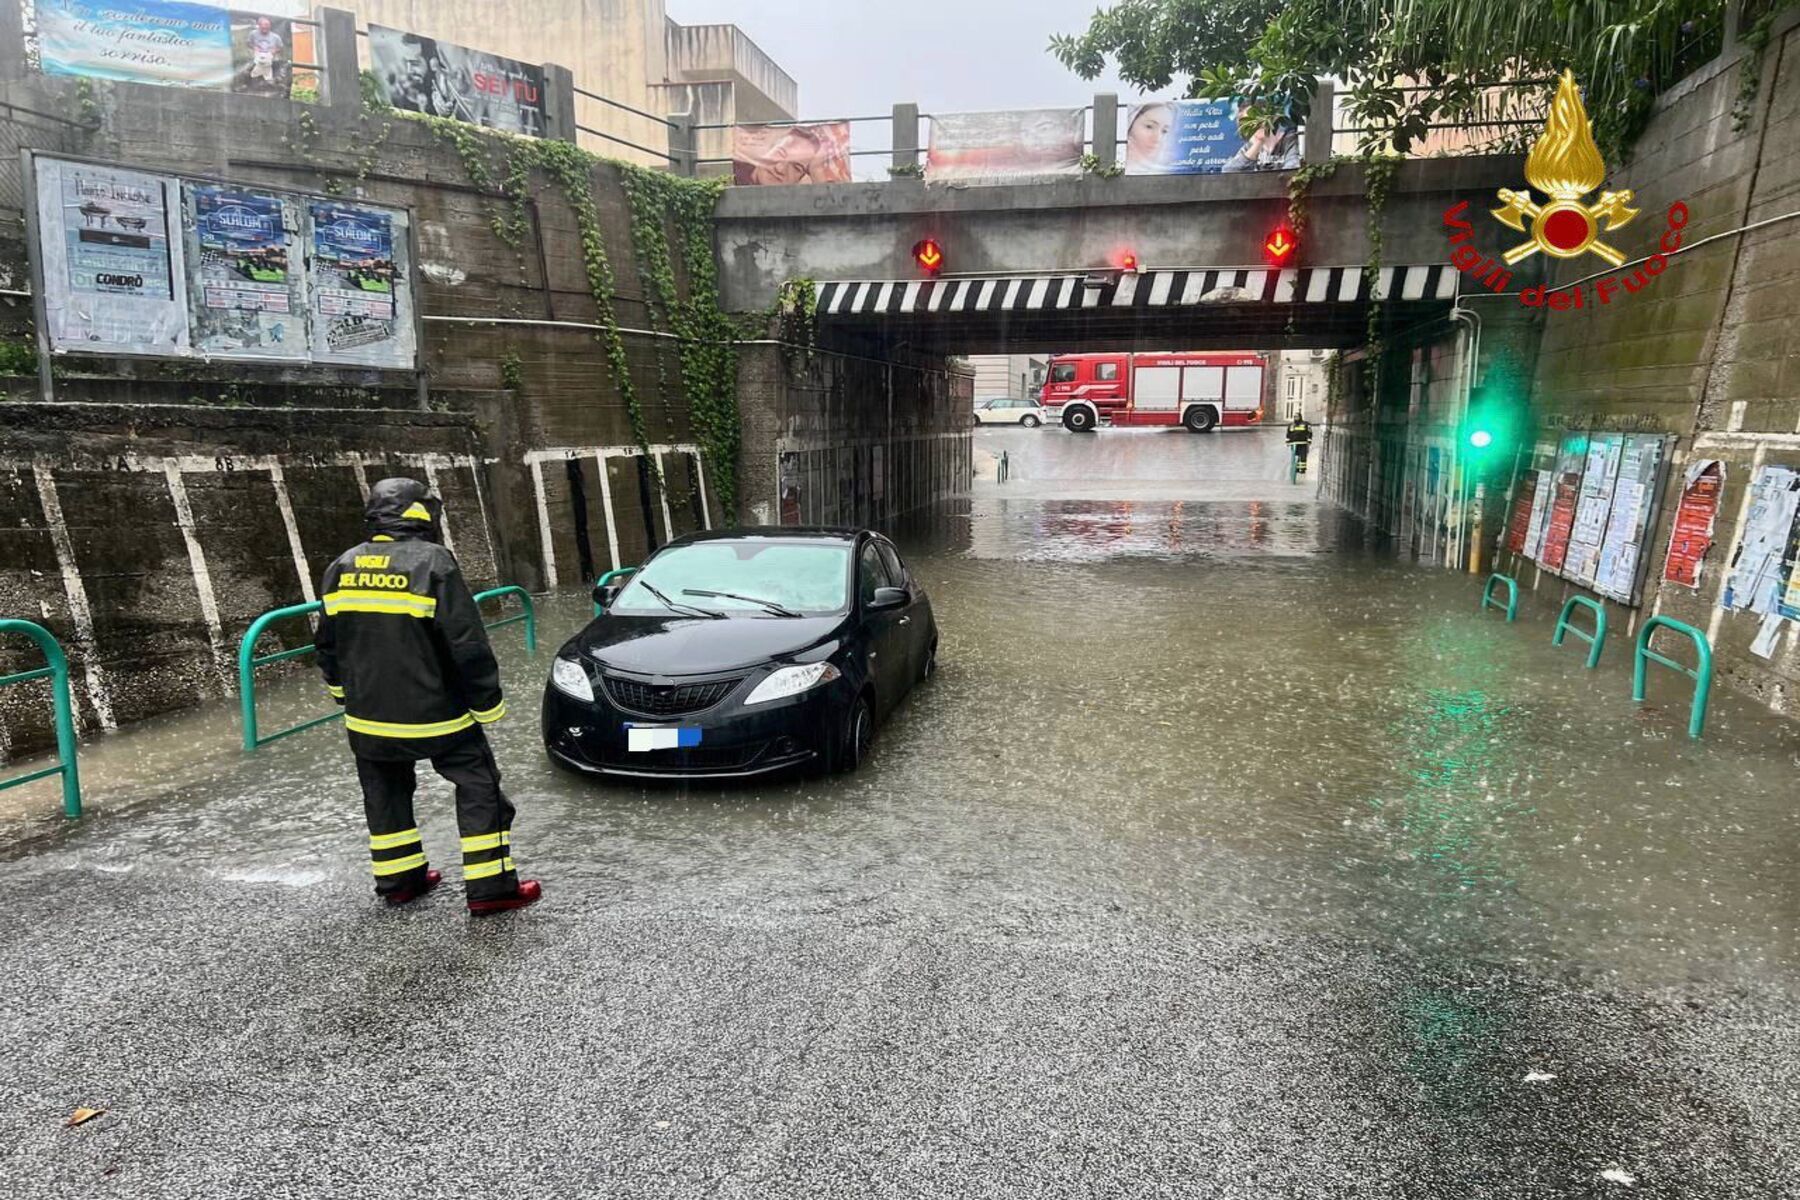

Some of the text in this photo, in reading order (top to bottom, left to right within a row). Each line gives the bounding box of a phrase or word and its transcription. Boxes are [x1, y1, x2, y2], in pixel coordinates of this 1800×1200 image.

[90, 23, 114, 38] tuo
[117, 27, 195, 46] fantastico
[474, 73, 538, 103] SEI TU
[358, 573, 408, 589] FUOCO
